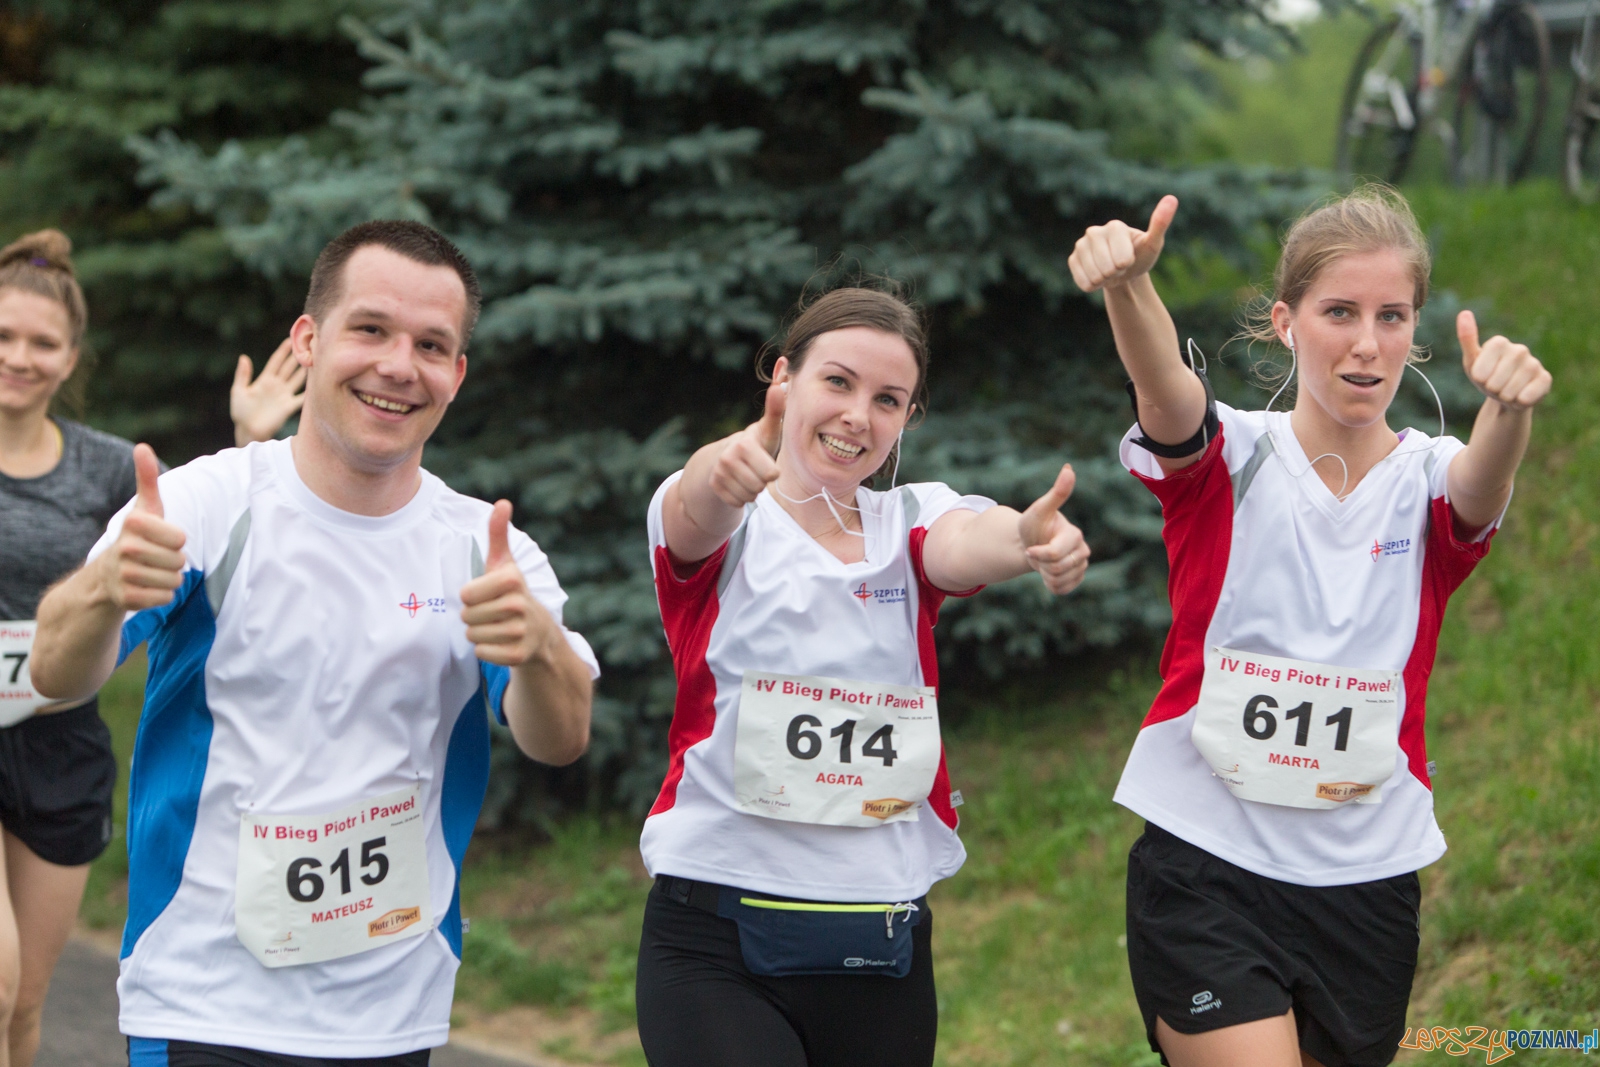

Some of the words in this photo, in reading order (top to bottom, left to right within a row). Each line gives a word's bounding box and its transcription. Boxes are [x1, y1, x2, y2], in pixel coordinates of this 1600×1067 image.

[1220, 657, 1240, 673] IV
[1244, 662, 1281, 683] Bieg
[1286, 668, 1330, 687] Piotr
[1335, 676, 1341, 689] i
[1346, 677, 1391, 693] Paweł
[756, 679, 777, 692] IV
[782, 681, 823, 701] Bieg
[829, 688, 873, 705] Piotr
[877, 693, 882, 706] i
[884, 694, 924, 709] Paweł
[1243, 694, 1353, 752] 611
[786, 714, 898, 767] 614
[1268, 752, 1320, 770] MARTA
[815, 772, 864, 786] AGATA
[1318, 786, 1342, 796] Piotr
[253, 824, 269, 839] IV
[275, 826, 318, 843] Bieg
[324, 816, 357, 837] Piotr
[361, 811, 365, 825] i
[370, 796, 416, 821] Paweł
[865, 803, 886, 812] Piotr
[286, 836, 390, 903] 615
[311, 897, 375, 924] MATEUSZ
[370, 920, 390, 933] Piotr
